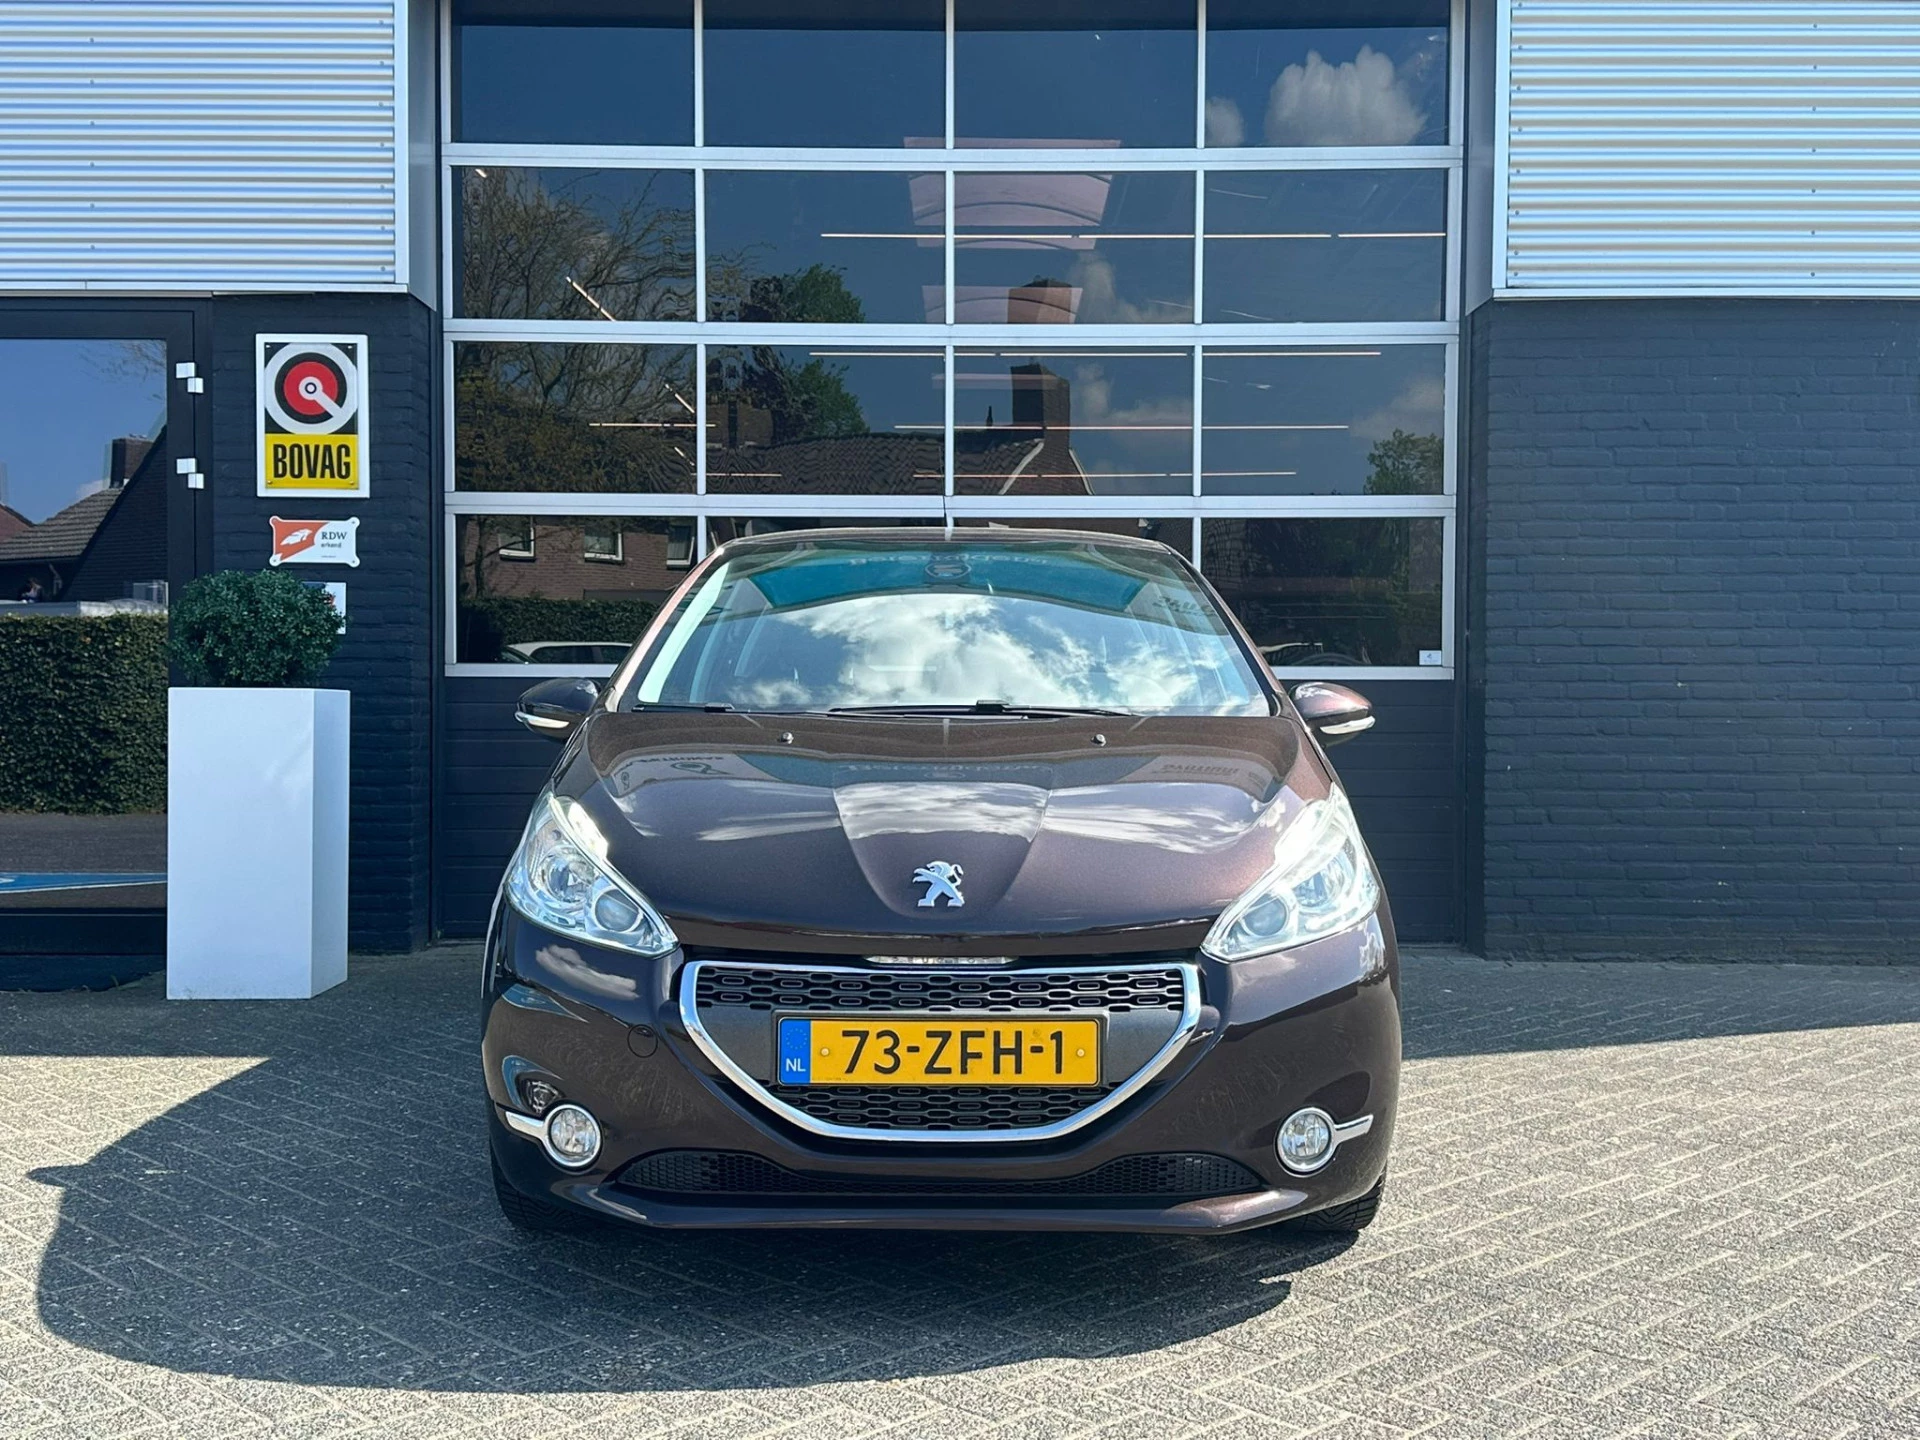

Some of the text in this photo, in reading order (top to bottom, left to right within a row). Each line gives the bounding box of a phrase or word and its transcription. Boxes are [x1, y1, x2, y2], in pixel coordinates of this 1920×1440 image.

[273, 443, 351, 480] BOVAG
[321, 531, 347, 540] RDW
[841, 1029, 1064, 1075] 73-ZFH-1
[785, 1058, 806, 1072] NL
